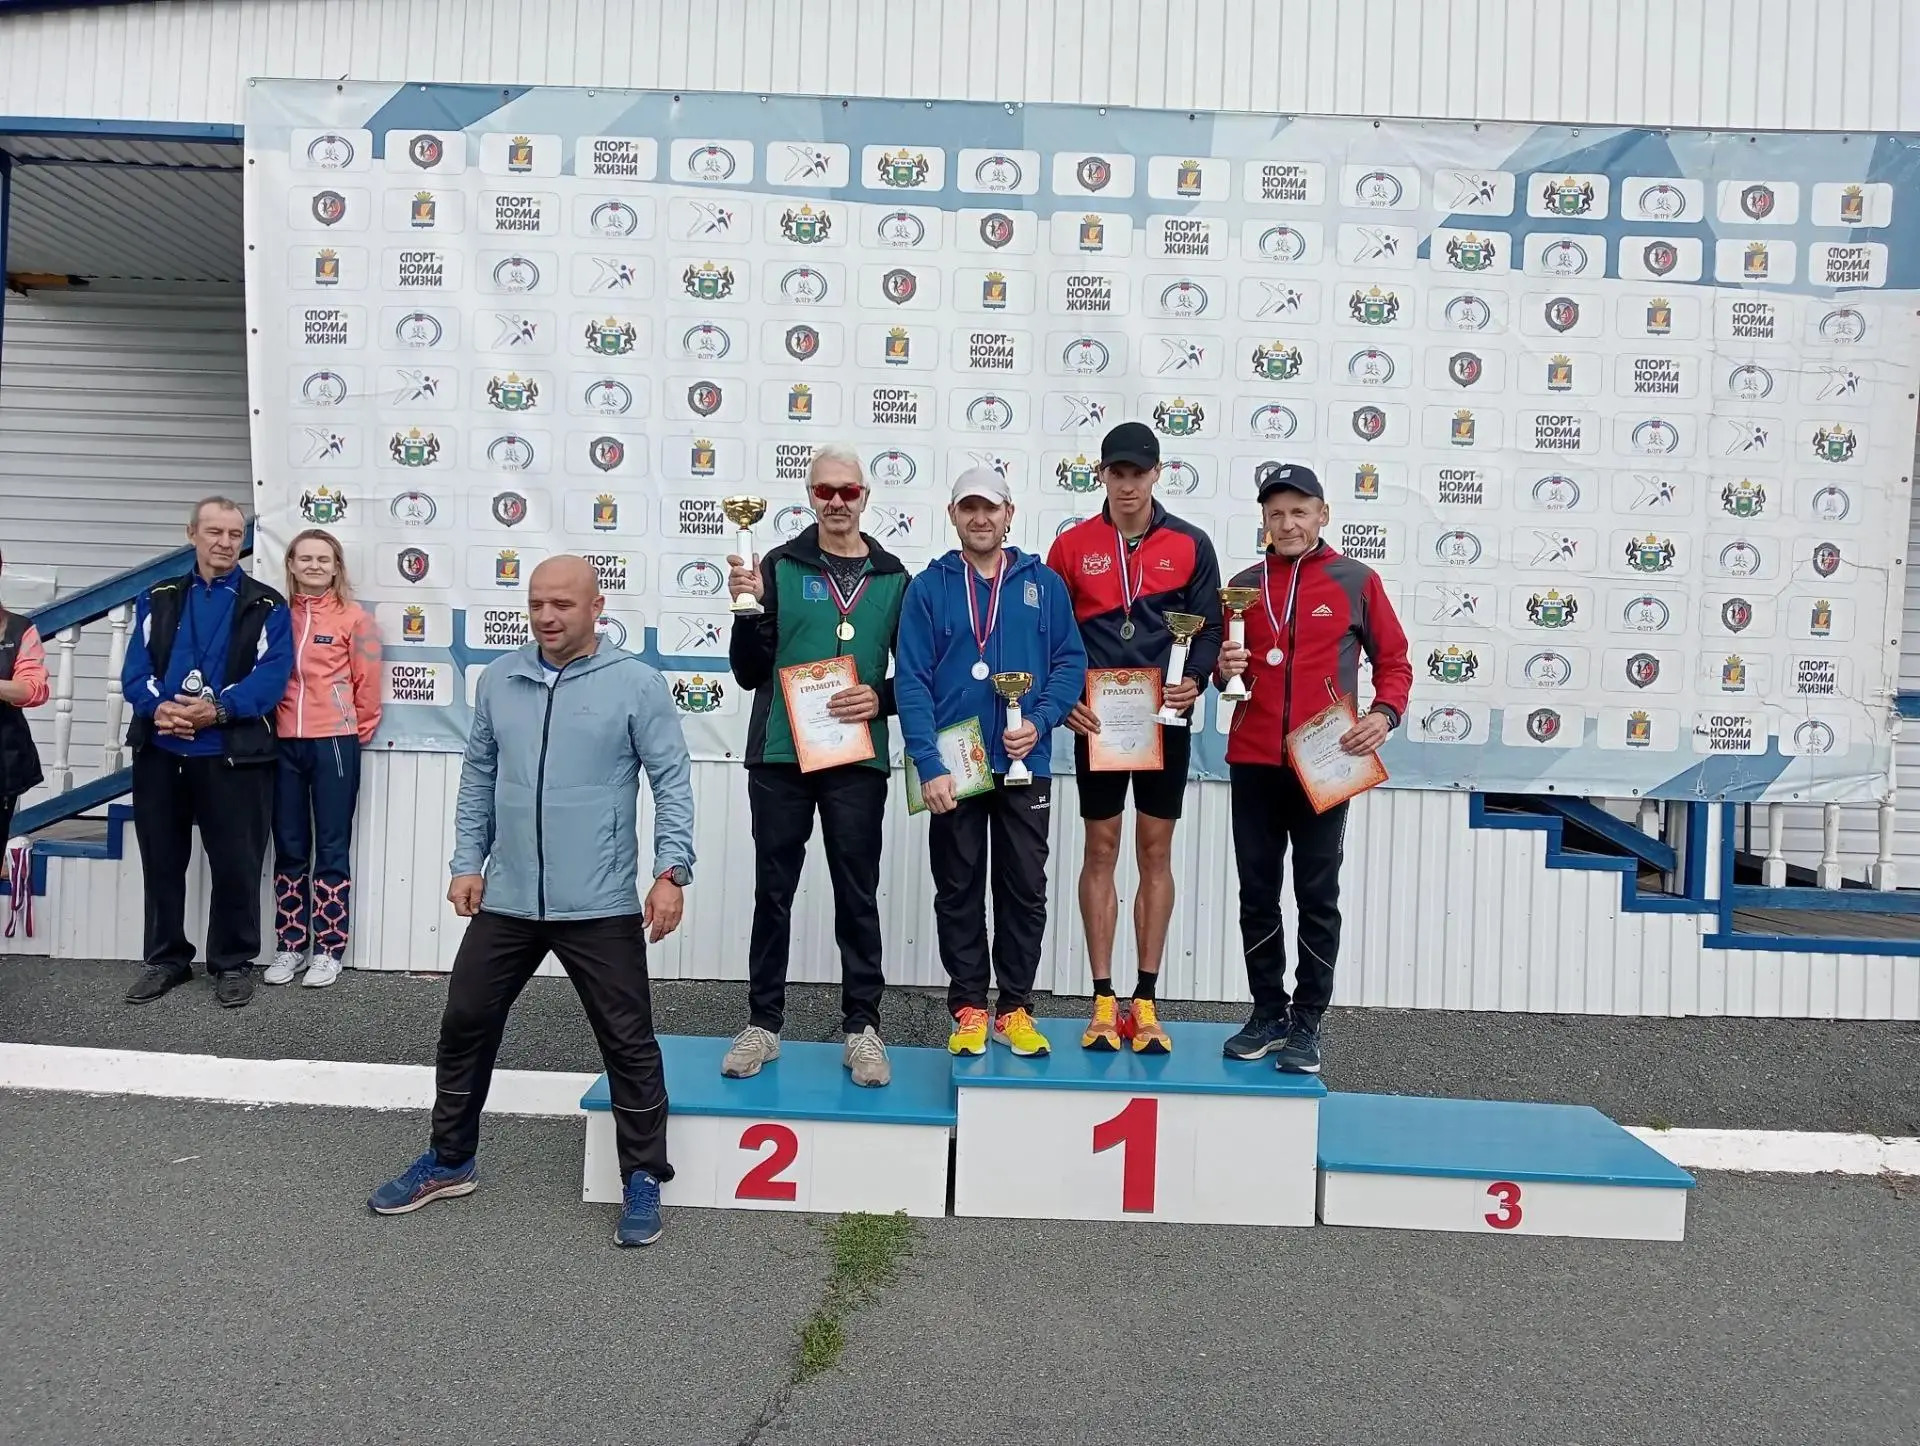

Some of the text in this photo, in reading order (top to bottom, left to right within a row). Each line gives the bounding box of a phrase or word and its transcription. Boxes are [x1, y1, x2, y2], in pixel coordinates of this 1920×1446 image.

[594, 141, 630, 152] СПОРТ
[594, 152, 638, 164] НОРМА
[594, 164, 637, 175] ЖИЗНИ
[1263, 166, 1299, 176] СПОРТ
[1262, 177, 1306, 188] НОРМА
[1262, 188, 1306, 200] ЖИЗНИ
[496, 196, 532, 207] СПОРТ
[496, 208, 540, 219] НОРМА
[496, 219, 539, 230] ЖИЗНИ
[1165, 220, 1202, 232] СПОРТ
[1165, 232, 1208, 243] НОРМА
[1164, 243, 1208, 255] ЖИЗНИ
[1828, 248, 1863, 259] СПОРТ
[400, 252, 435, 262] СПОРТ
[400, 264, 442, 274] НОРМА
[1827, 259, 1870, 270] НОРМА
[399, 276, 442, 286] ЖИЗНИ
[1067, 276, 1103, 286] СПОРТ
[1826, 271, 1868, 282] ЖИЗНИ
[1067, 288, 1111, 298] НОРМА
[1066, 300, 1110, 310] ЖИЗНИ
[1732, 303, 1768, 314] СПОРТ
[305, 310, 340, 320] СПОРТ
[1733, 314, 1774, 326] НОРМА
[305, 322, 347, 332] НОРМА
[1733, 326, 1773, 338] ЖИЗНИ
[306, 334, 346, 344] ЖИЗНИ
[970, 334, 1006, 344] СПОРТ
[970, 346, 1013, 357] НОРМА
[970, 357, 1013, 369] ЖИЗНИ
[1635, 359, 1671, 370] СПОРТ
[1635, 370, 1679, 382] НОРМА
[1634, 382, 1678, 393] ЖИЗНИ
[874, 389, 909, 400] СПОРТ
[873, 401, 916, 412] НОРМА
[873, 412, 916, 424] ЖИЗНИ
[1536, 416, 1573, 426] СПОРТ
[1536, 427, 1580, 438] НОРМА
[1536, 438, 1580, 449] ЖИЗНИ
[776, 445, 812, 456] СПОРТ
[1440, 470, 1475, 481] СПОРТ
[1439, 481, 1482, 492] НОРМА
[1439, 492, 1482, 504] ЖИЗНИ
[680, 500, 716, 511] СПОРТ
[680, 512, 723, 523] НОРМА
[680, 523, 723, 534] ЖИЗНИ
[1342, 524, 1380, 535] СПОРТ
[1342, 536, 1385, 547] НОРМА
[1342, 546, 1386, 559] ЖИЗНИ
[484, 611, 520, 622] СПОРТ
[484, 622, 528, 634] НОРМА
[484, 634, 528, 645] ЖИЗНИ
[392, 666, 428, 677] СПОРТ
[1799, 661, 1829, 671] СПОРТ
[1798, 672, 1834, 682] НОРМА
[393, 678, 434, 689] НОРМА
[800, 680, 842, 694] ГРАМОТА
[1797, 683, 1833, 694] ЖИЗНИ
[393, 689, 434, 700] ЖИЗНИ
[1102, 688, 1144, 696] ГРАМОТА
[1711, 716, 1746, 727] СПОРТ
[1303, 716, 1340, 742] ГРАМОТА
[1710, 728, 1751, 738] НОРМА
[1710, 739, 1750, 750] ЖИЗНИ
[958, 738, 972, 779] ГРАМОТА
[1093, 1098, 1158, 1214] 1
[735, 1124, 798, 1202] 2
[1485, 1182, 1523, 1229] 3
